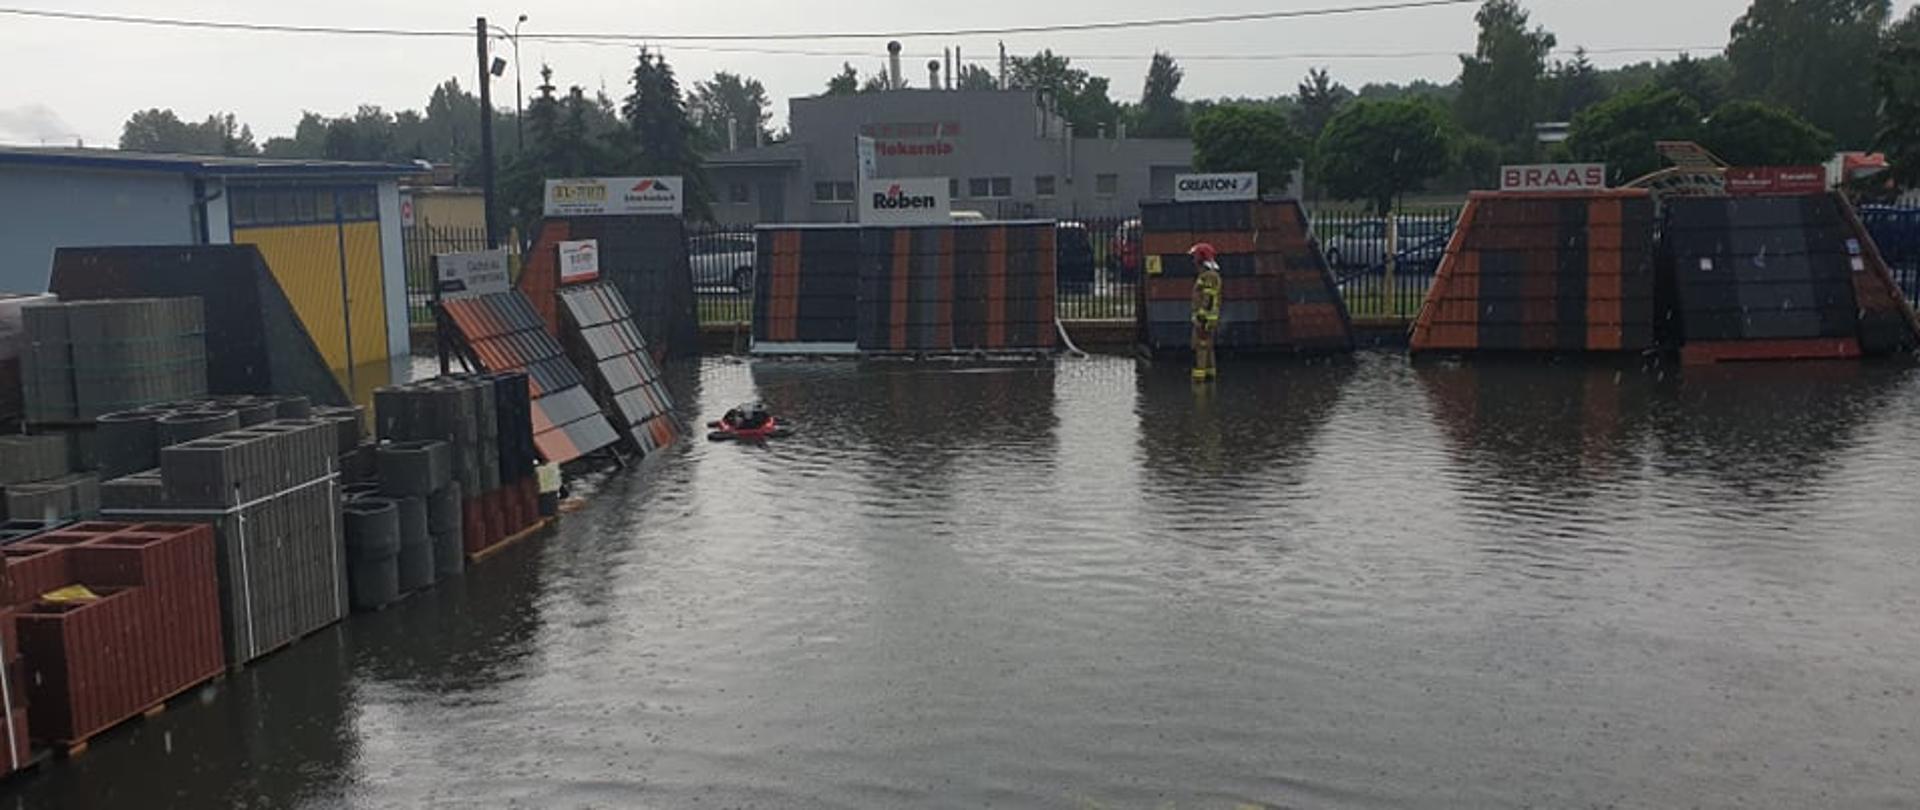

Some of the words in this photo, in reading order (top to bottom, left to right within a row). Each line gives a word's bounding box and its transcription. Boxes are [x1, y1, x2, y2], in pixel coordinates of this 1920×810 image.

[1179, 178, 1237, 191] CREATON
[1504, 167, 1602, 188] BRAAS
[873, 184, 935, 209] Röben
